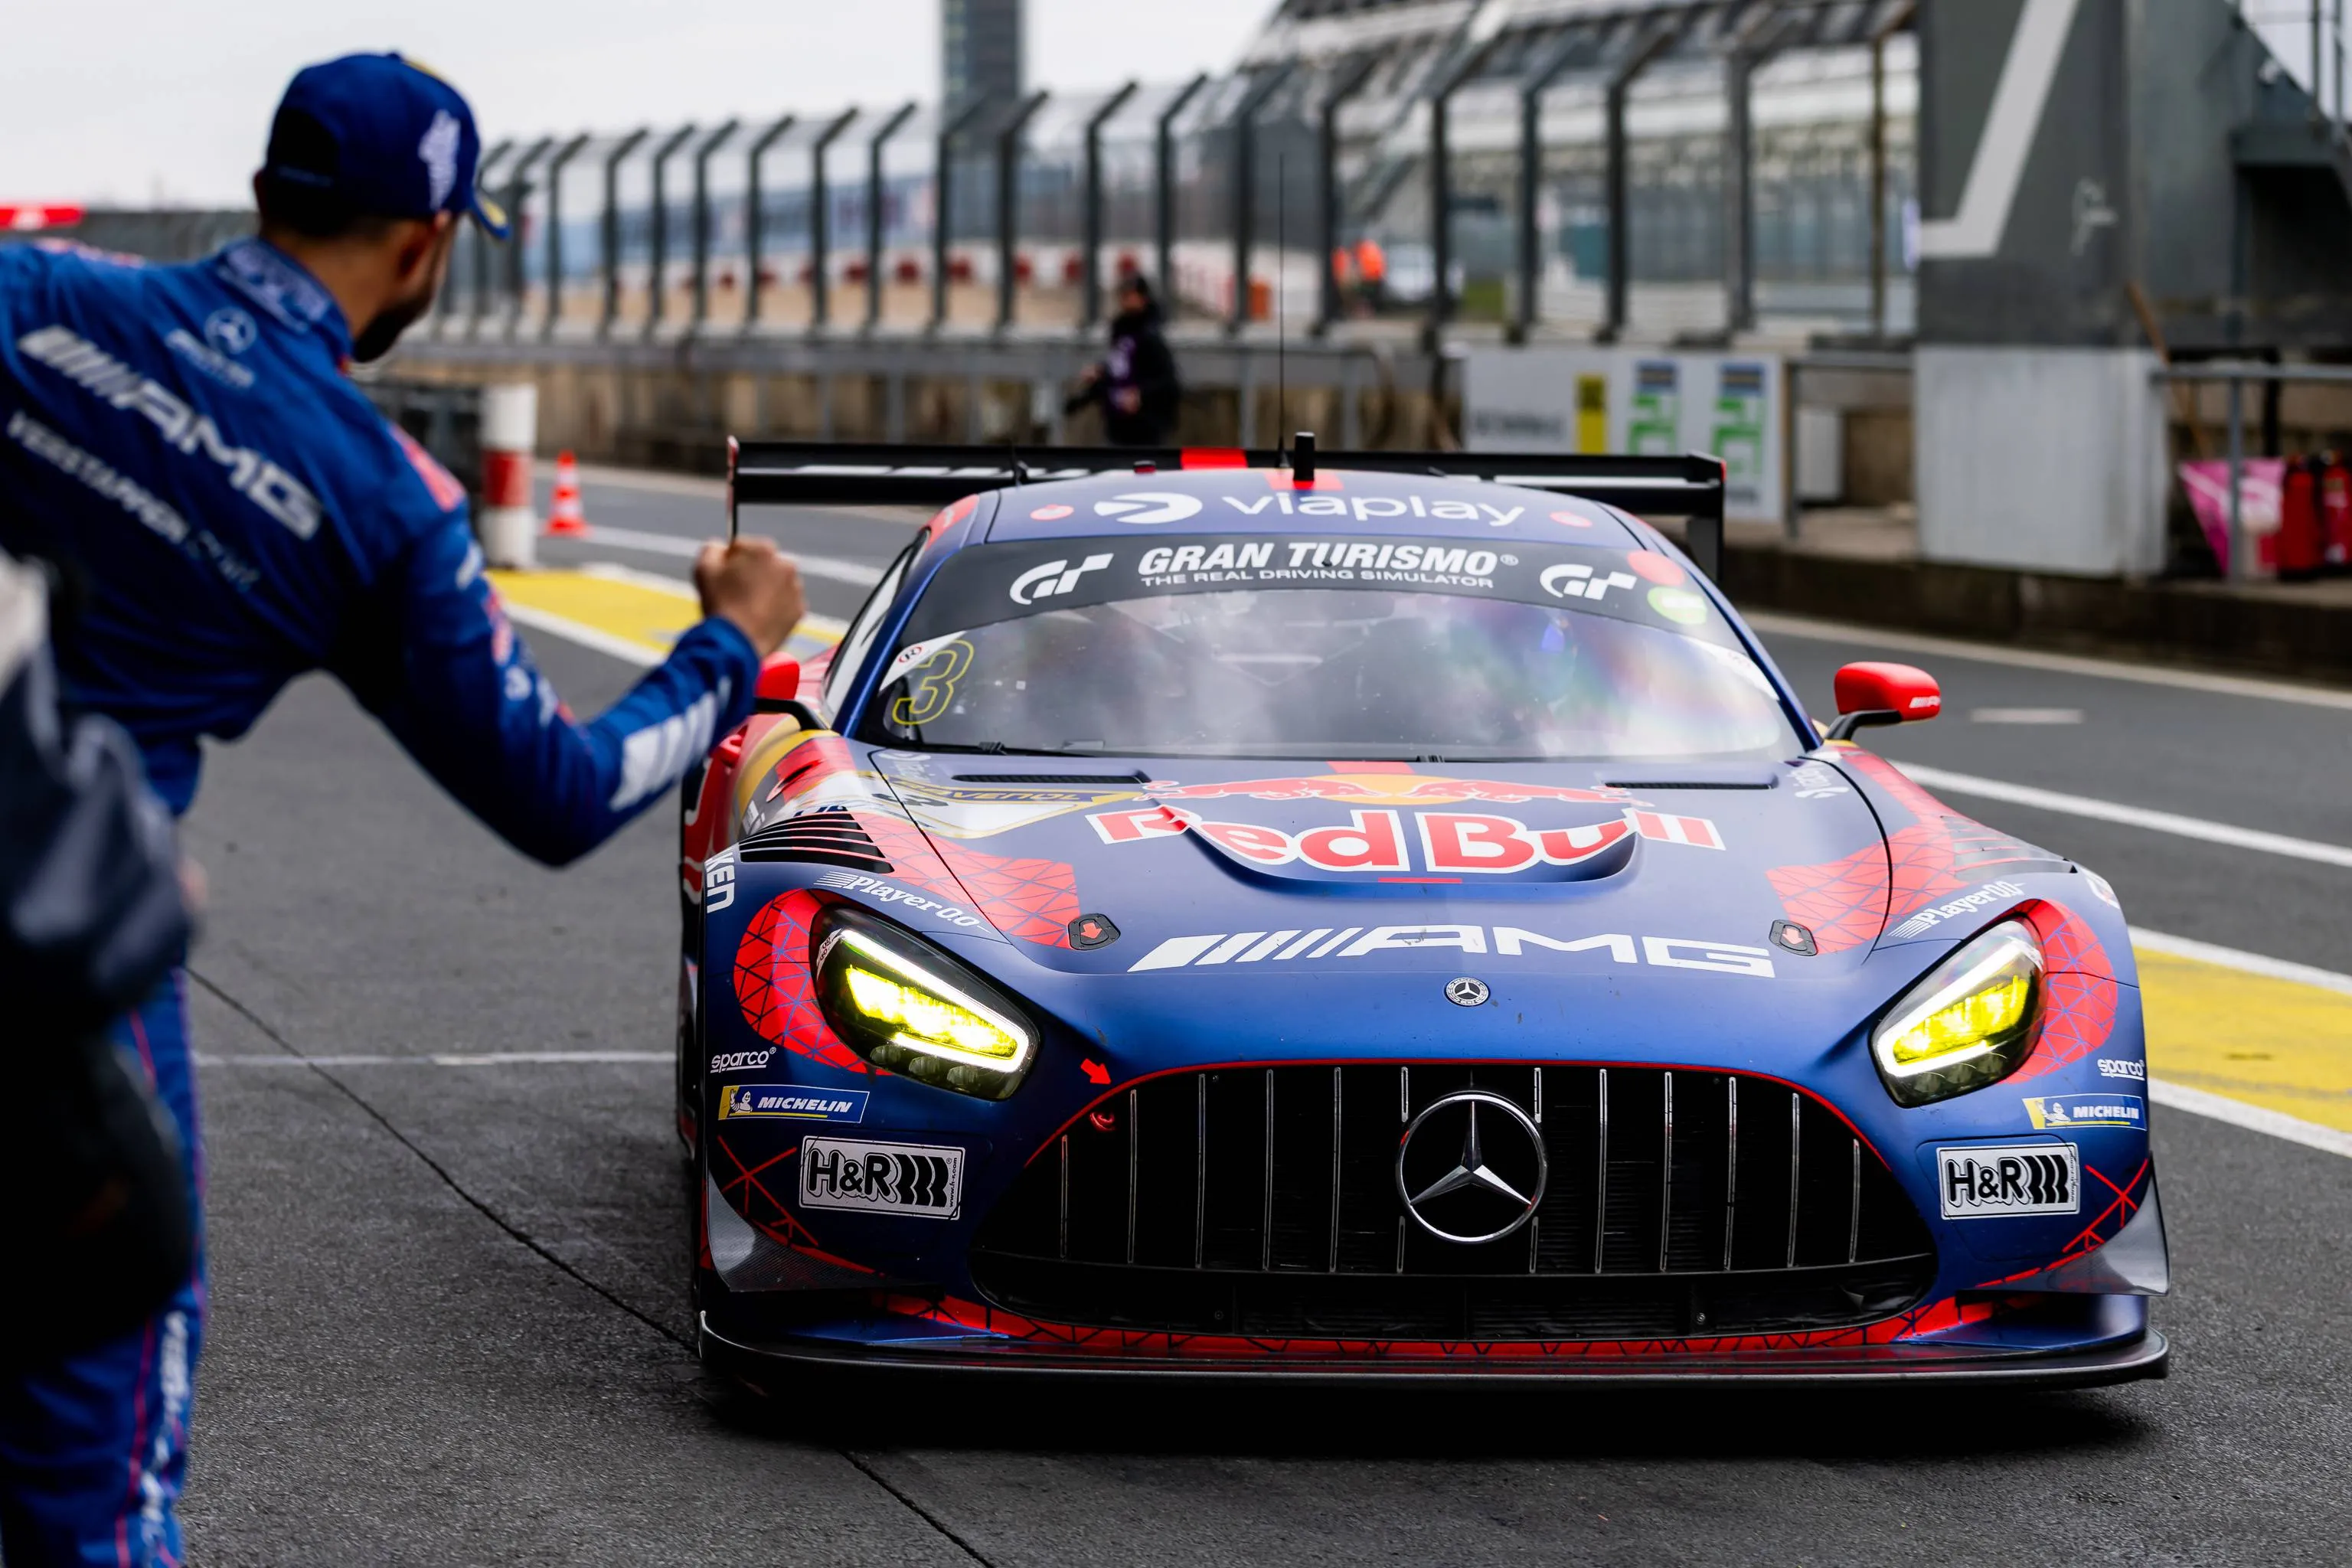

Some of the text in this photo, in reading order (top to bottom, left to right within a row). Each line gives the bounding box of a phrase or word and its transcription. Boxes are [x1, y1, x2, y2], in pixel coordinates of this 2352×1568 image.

[1222, 491, 1525, 527] viaplay
[1138, 543, 1275, 575] GRAN
[1141, 569, 1494, 589] THE REAL DRIVING SIMULATOR
[892, 639, 975, 725] 3
[1086, 805, 1726, 874] Red Bull
[1353, 924, 1775, 978] AMG
[757, 1096, 853, 1112] MICHELIN
[2073, 1105, 2140, 1119] MICHELIN
[807, 1148, 898, 1202] H&R
[1945, 1157, 2031, 1207] H&R
